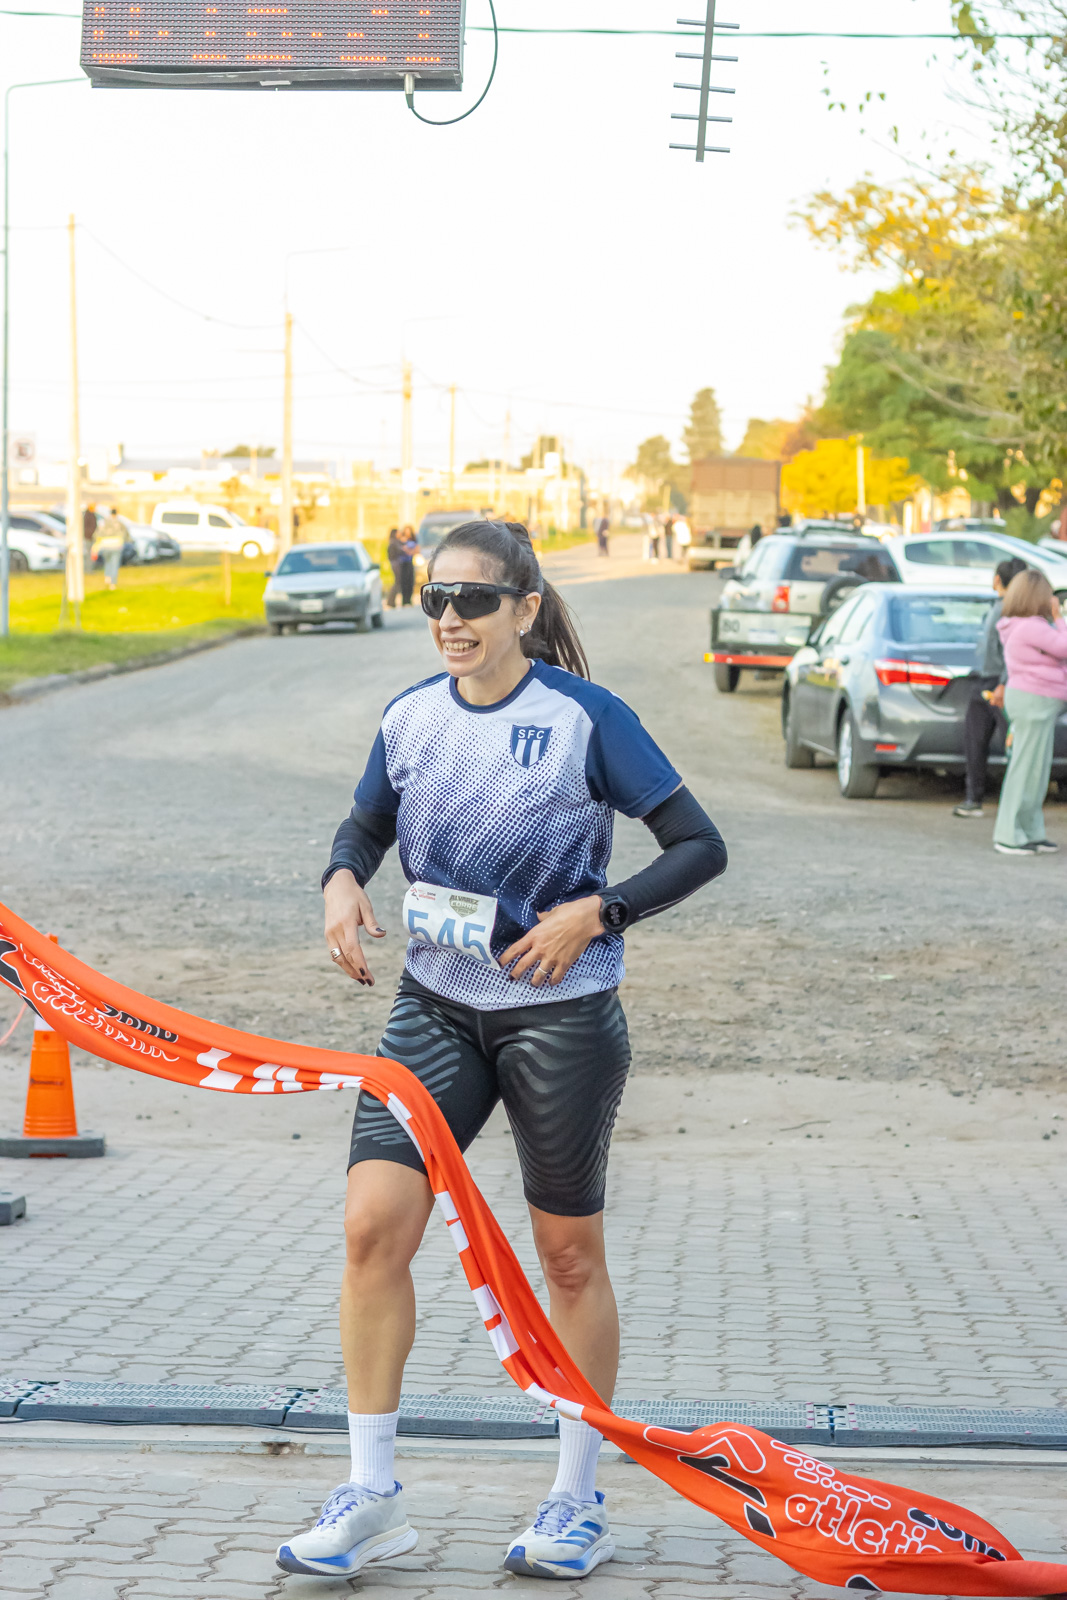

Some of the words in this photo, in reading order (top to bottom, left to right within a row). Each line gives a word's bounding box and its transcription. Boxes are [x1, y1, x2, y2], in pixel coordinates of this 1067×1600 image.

[517, 728, 545, 740] SFC
[450, 900, 478, 911] CORRE
[408, 909, 491, 965] 545
